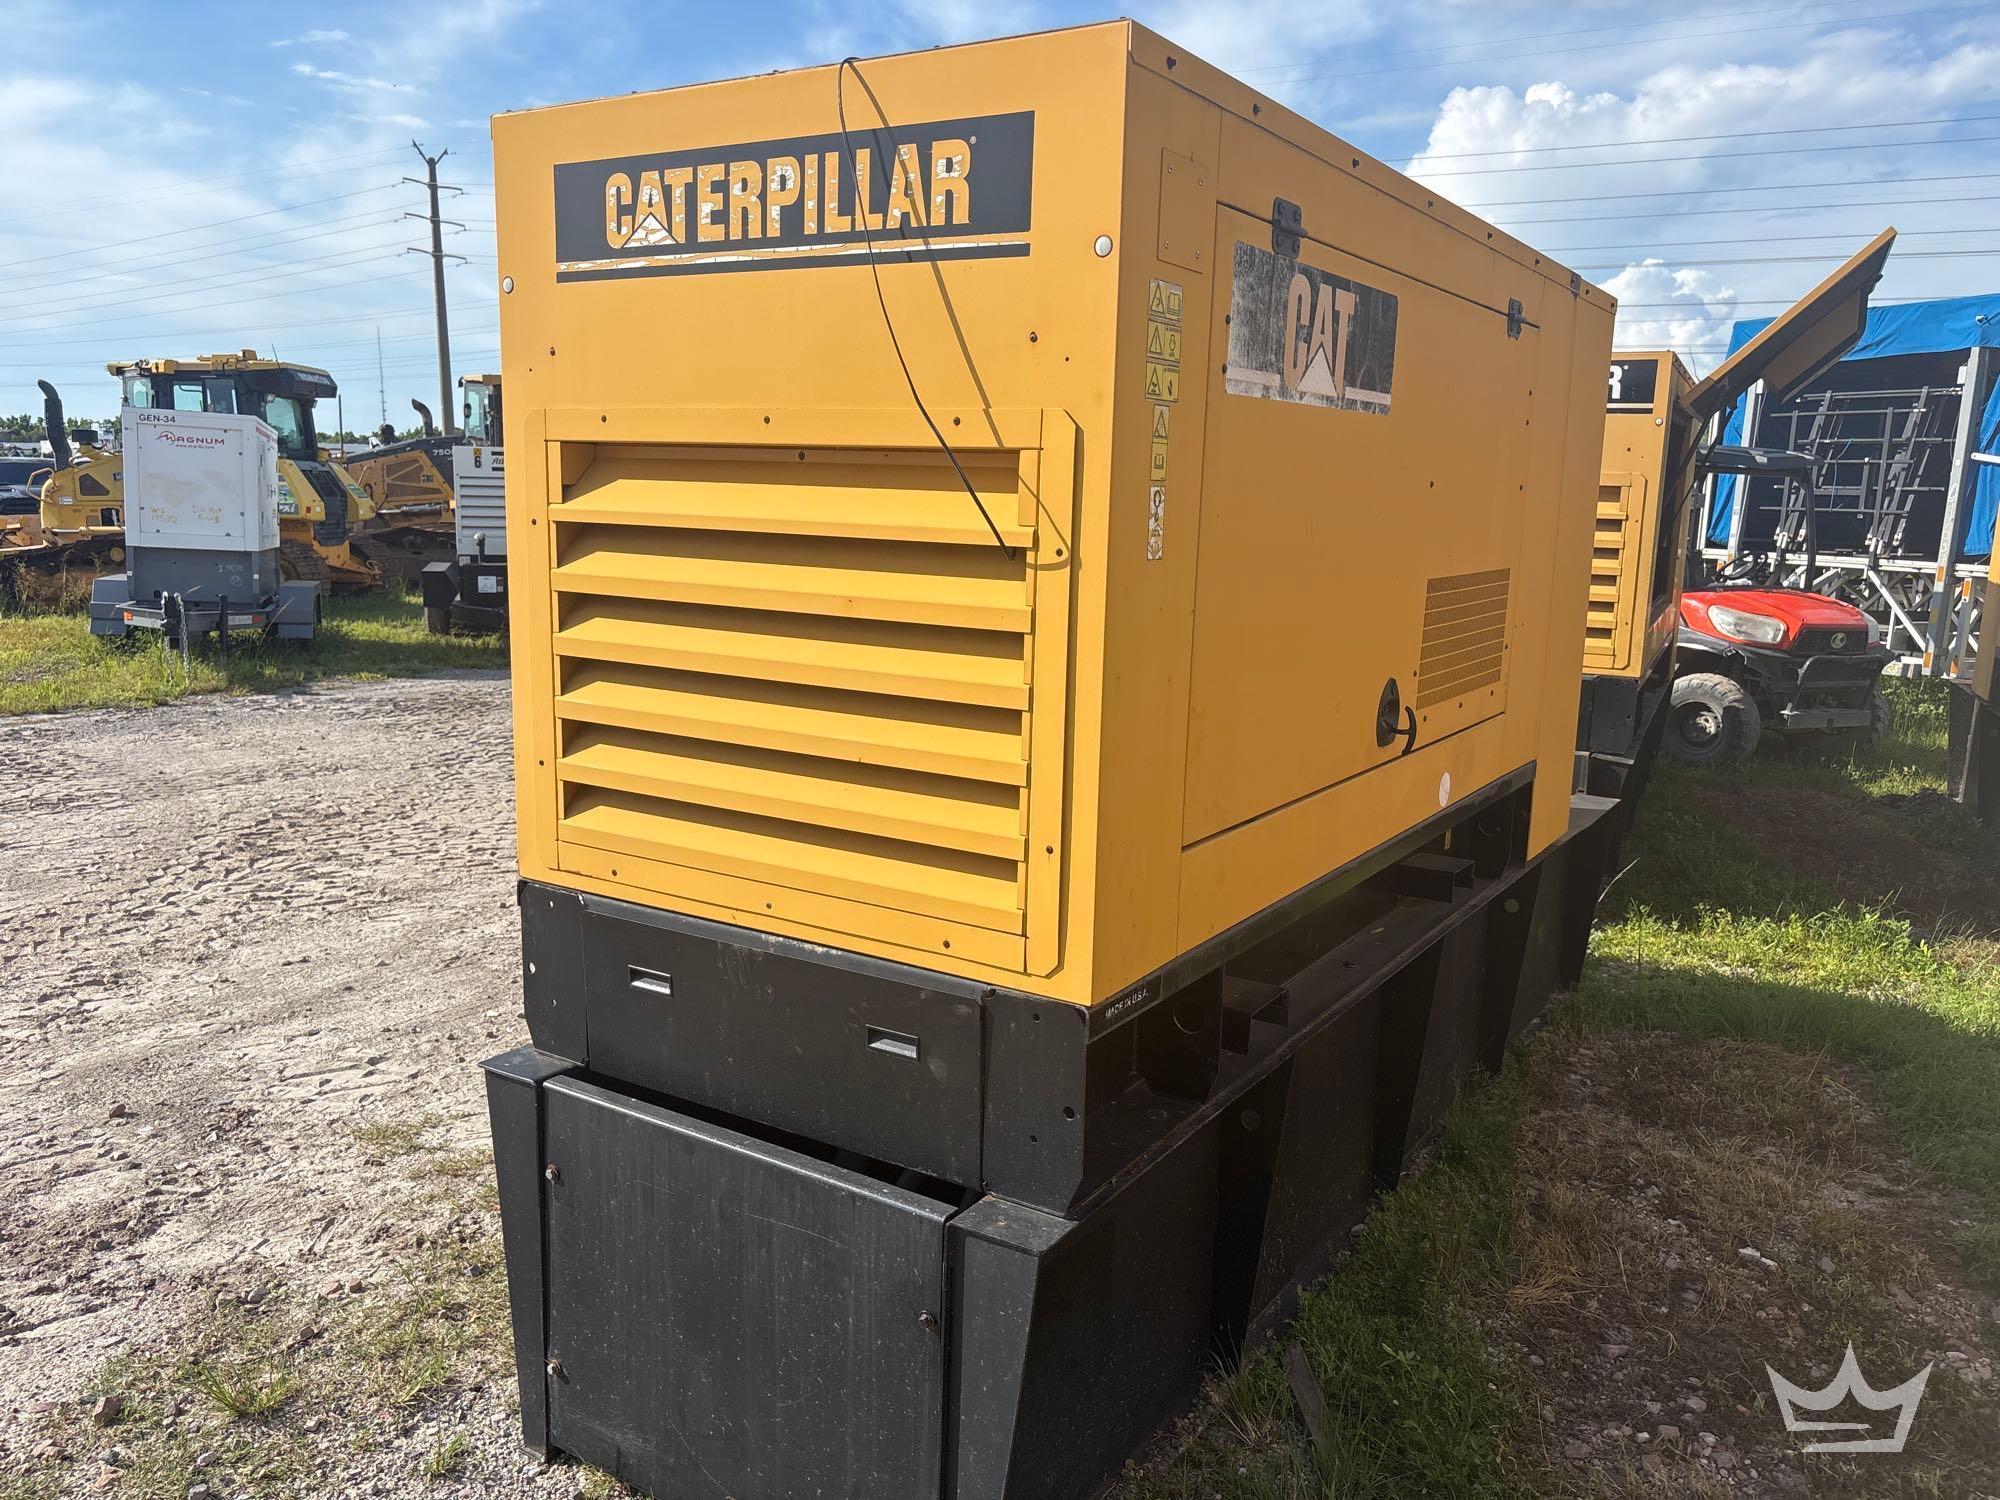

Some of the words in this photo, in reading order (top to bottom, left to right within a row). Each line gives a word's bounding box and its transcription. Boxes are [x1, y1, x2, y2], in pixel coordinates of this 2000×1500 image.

[603, 138, 972, 250] CATERPILLAR
[1284, 272, 1356, 398] CAT
[138, 413, 177, 424] GEN-34
[155, 431, 225, 446] MAGNUM
